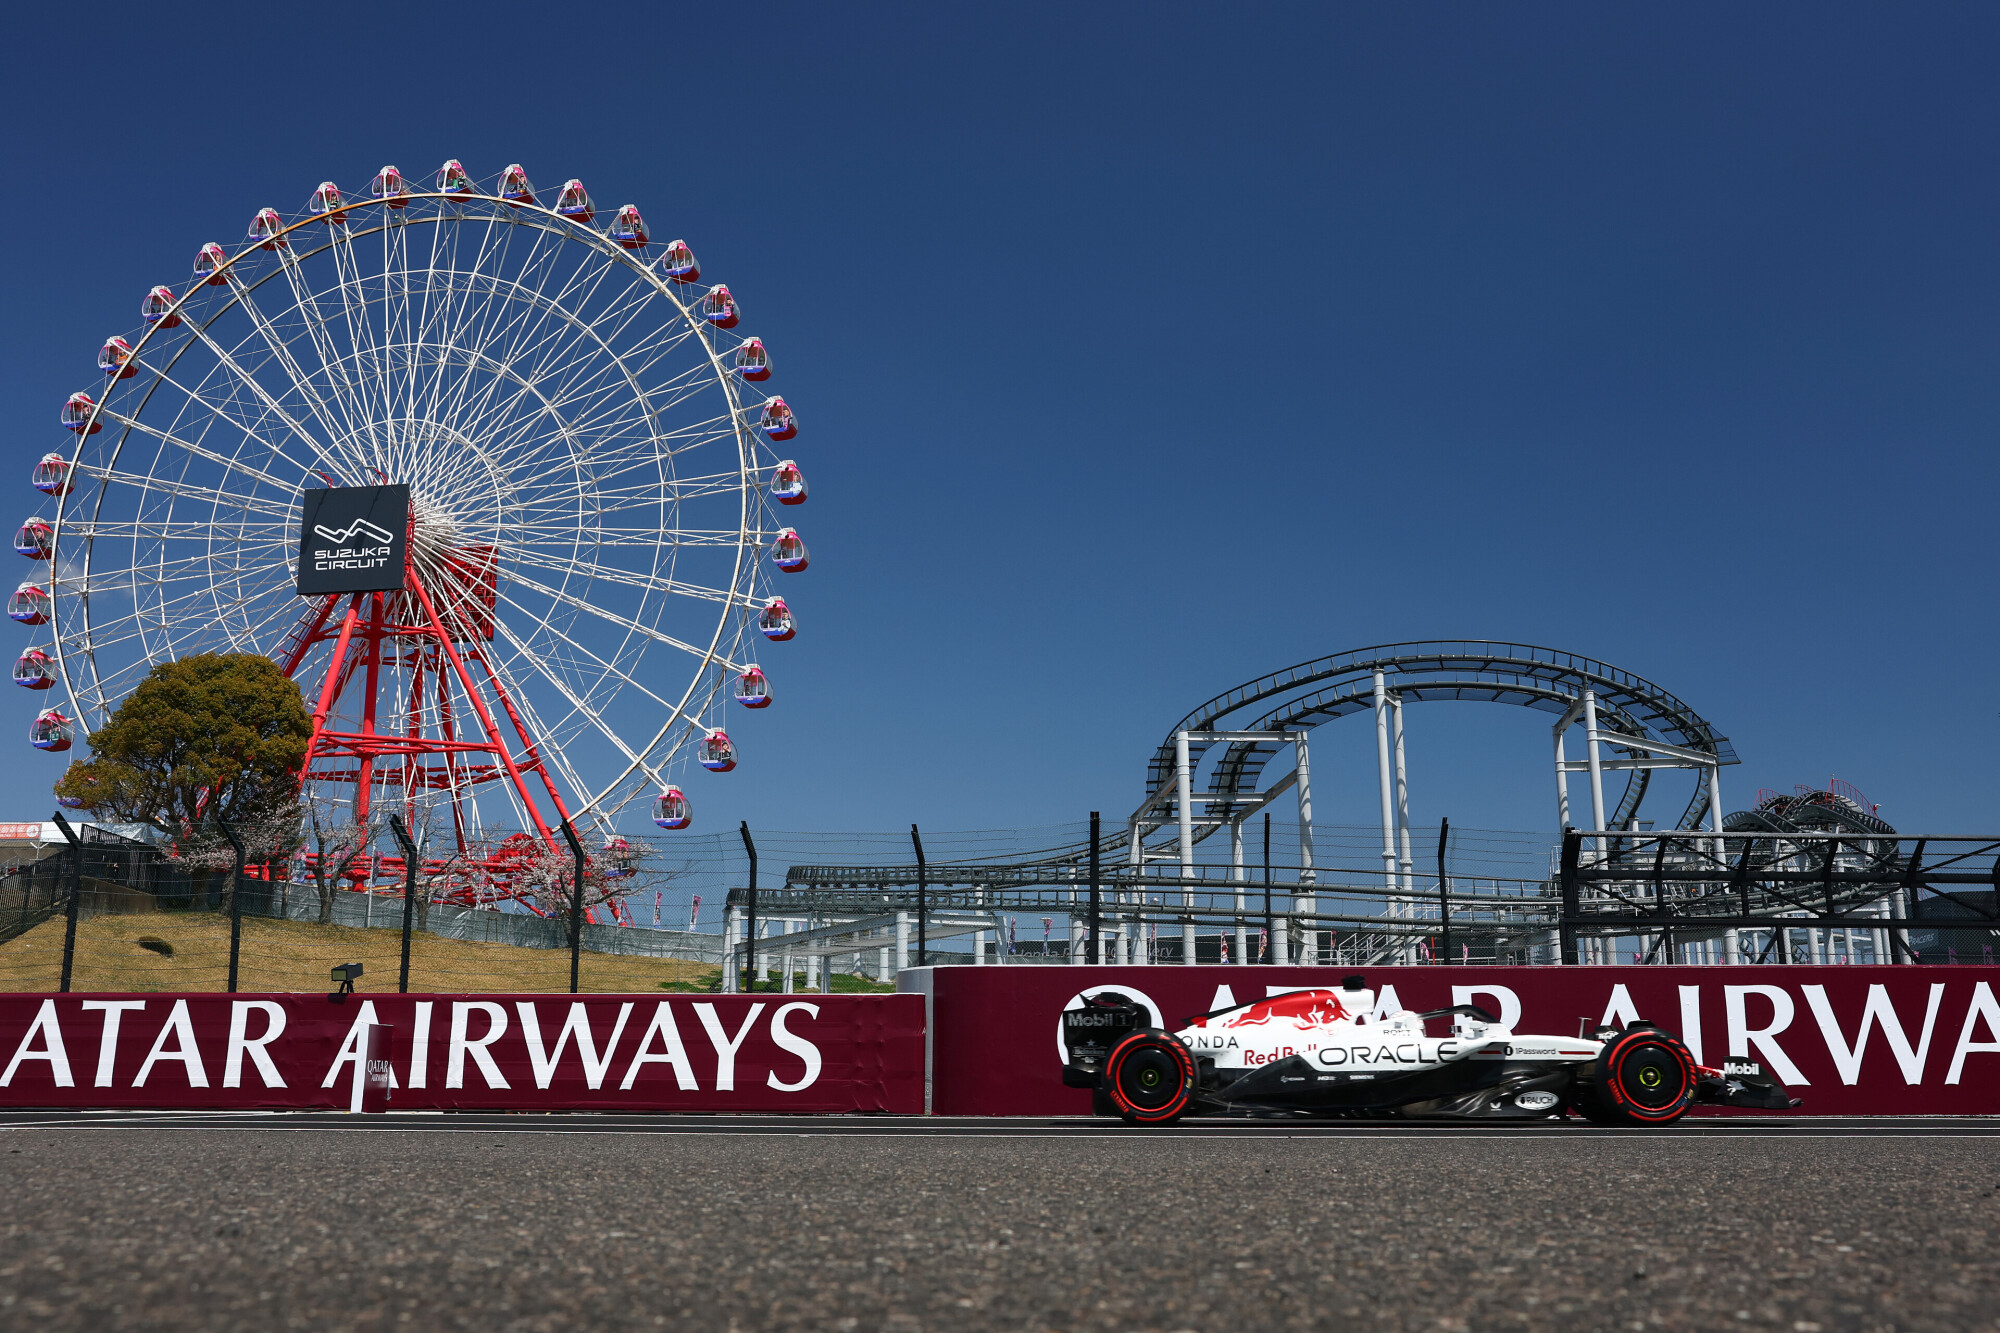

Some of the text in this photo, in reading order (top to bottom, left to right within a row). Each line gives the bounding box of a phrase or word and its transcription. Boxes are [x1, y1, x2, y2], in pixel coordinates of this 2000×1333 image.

[314, 546, 391, 559] SUZUKA
[315, 558, 388, 571] CIRCUIT
[1067, 1013, 1113, 1027] Mobil
[0, 998, 823, 1091] ATAR AIRWAYS
[1515, 1047, 1557, 1055] 1Password
[1318, 1041, 1459, 1066] ORACLE
[367, 1059, 389, 1075] QATAR
[1723, 1062, 1760, 1076] Mobil
[1525, 1096, 1554, 1104] RAUCH
